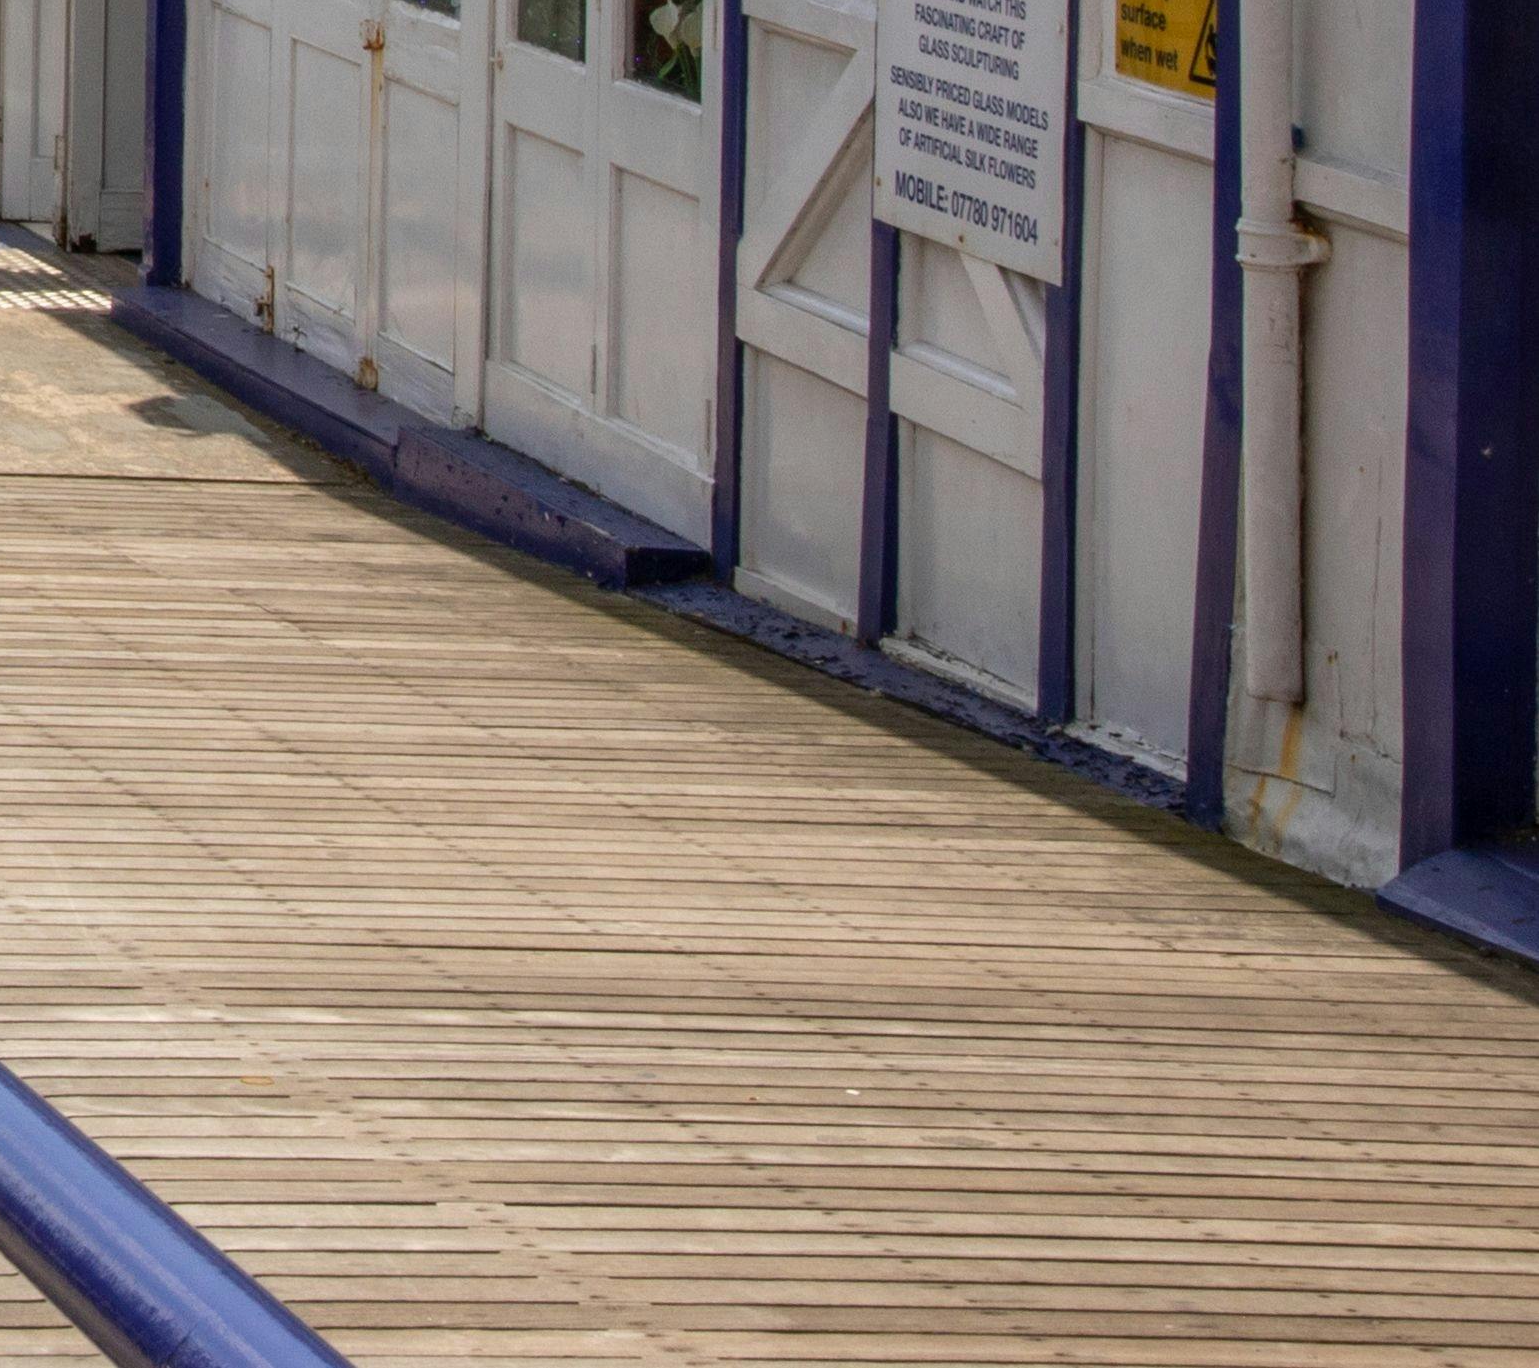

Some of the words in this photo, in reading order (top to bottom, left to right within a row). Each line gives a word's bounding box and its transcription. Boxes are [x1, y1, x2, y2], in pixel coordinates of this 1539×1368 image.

[914, 3, 976, 37] FASCINATING
[977, 20, 1010, 46] CRAFT
[1011, 29, 1025, 50] OF
[1121, 3, 1166, 31] surface
[919, 34, 949, 60] GLASS
[951, 43, 1019, 80] SCULPTURING
[1121, 37, 1152, 64] when
[1155, 48, 1178, 72] wet
[890, 65, 934, 94] SENSIBLY
[936, 79, 971, 106] PRICED
[973, 90, 1004, 117] GLASS
[1006, 100, 1049, 131] MODELS
[898, 98, 923, 121] ALSO
[925, 106, 939, 127] WE
[941, 112, 966, 136] HAVE
[967, 120, 974, 137] A
[976, 121, 1001, 147] WIDE
[1003, 130, 1038, 159] RANGE
[899, 127, 912, 147] OF
[913, 131, 963, 165] ARTIFICIAL
[965, 149, 986, 172] SILK
[988, 156, 1036, 189] FLOWERS
[895, 170, 948, 213] MOBILE:
[951, 191, 988, 227] 07780
[991, 205, 1038, 245] 971604
